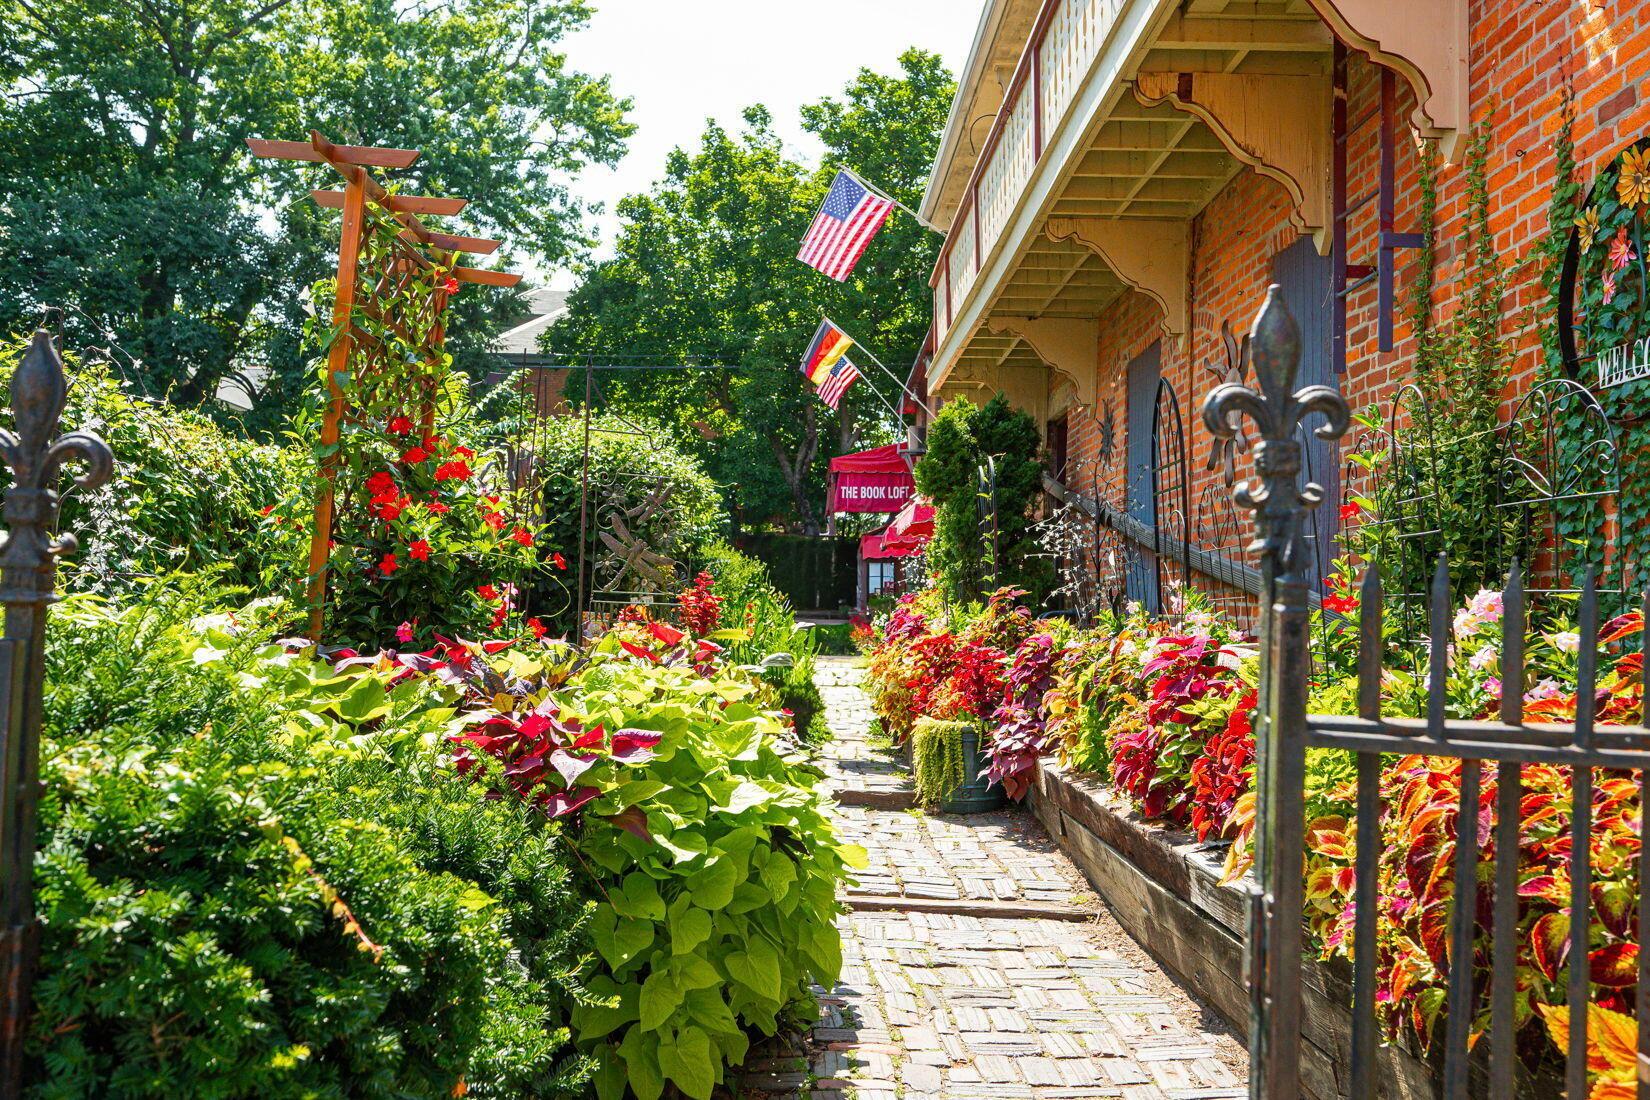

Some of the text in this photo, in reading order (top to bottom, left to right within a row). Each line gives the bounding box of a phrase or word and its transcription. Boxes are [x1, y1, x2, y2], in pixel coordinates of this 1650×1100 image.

[841, 486, 909, 498] THE BOOK LOFT
